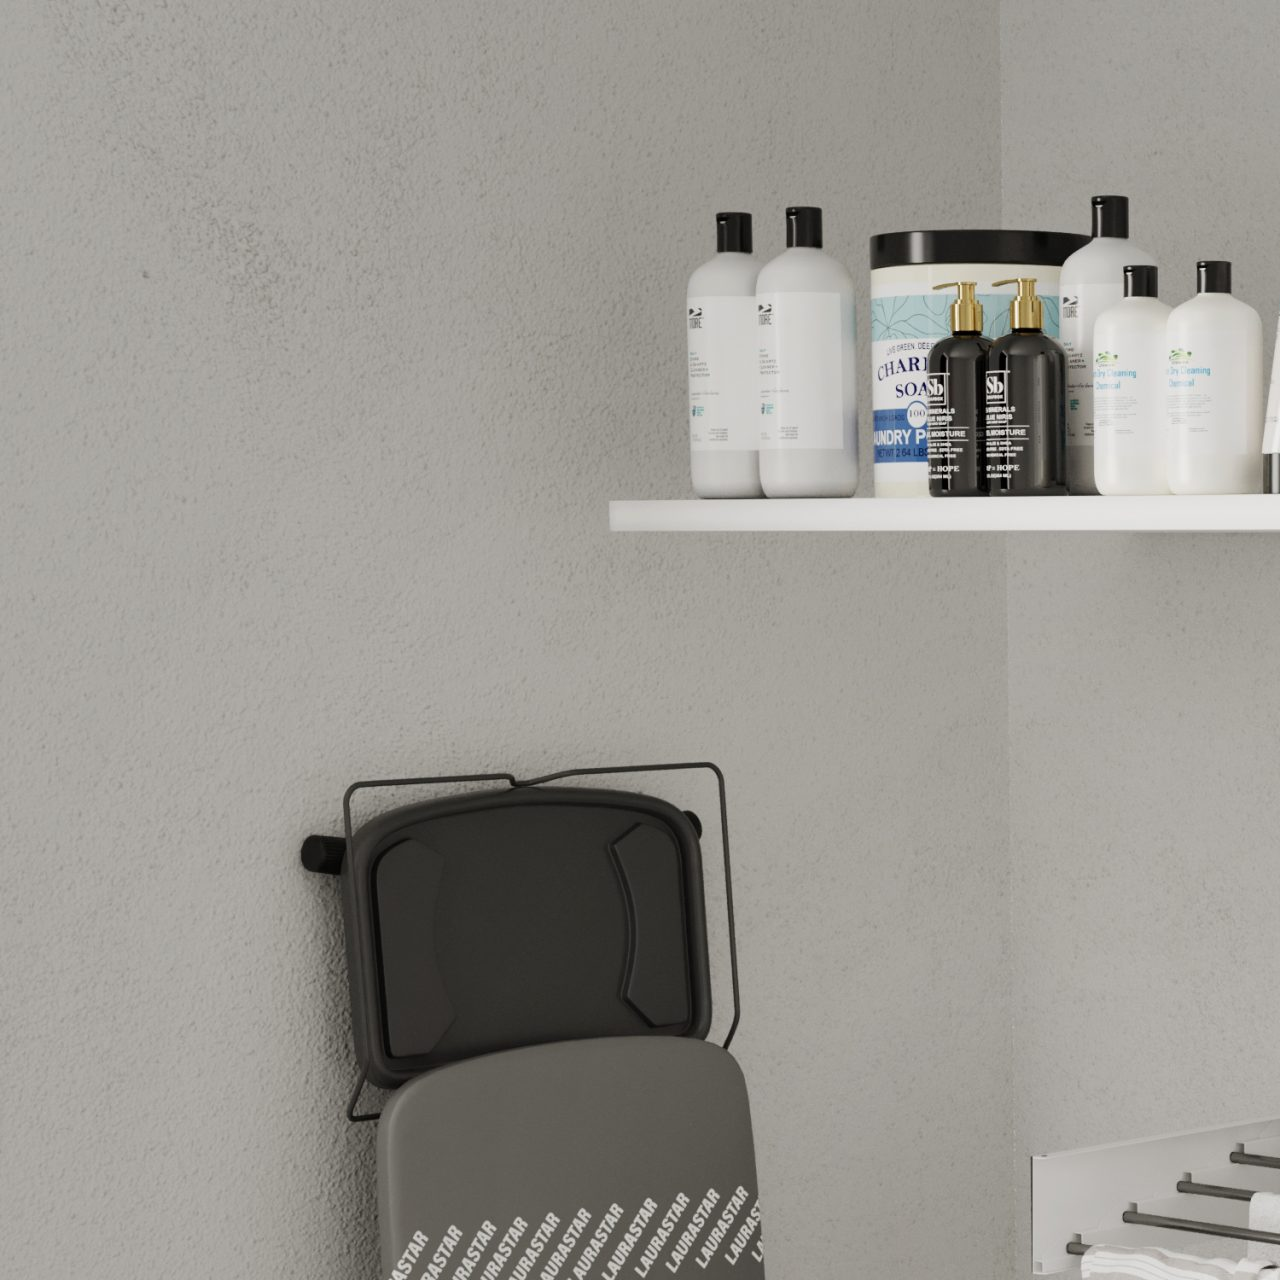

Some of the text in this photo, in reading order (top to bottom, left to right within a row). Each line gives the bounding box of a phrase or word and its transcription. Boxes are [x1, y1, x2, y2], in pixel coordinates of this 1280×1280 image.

[986, 376, 1004, 394] Sb
[874, 429, 912, 446] UNDRY
[908, 409, 926, 419] 100
[634, 1192, 690, 1279] LAURASTAR
[665, 1188, 721, 1274] LAURASTAR
[696, 1185, 750, 1269] LAURASTAR
